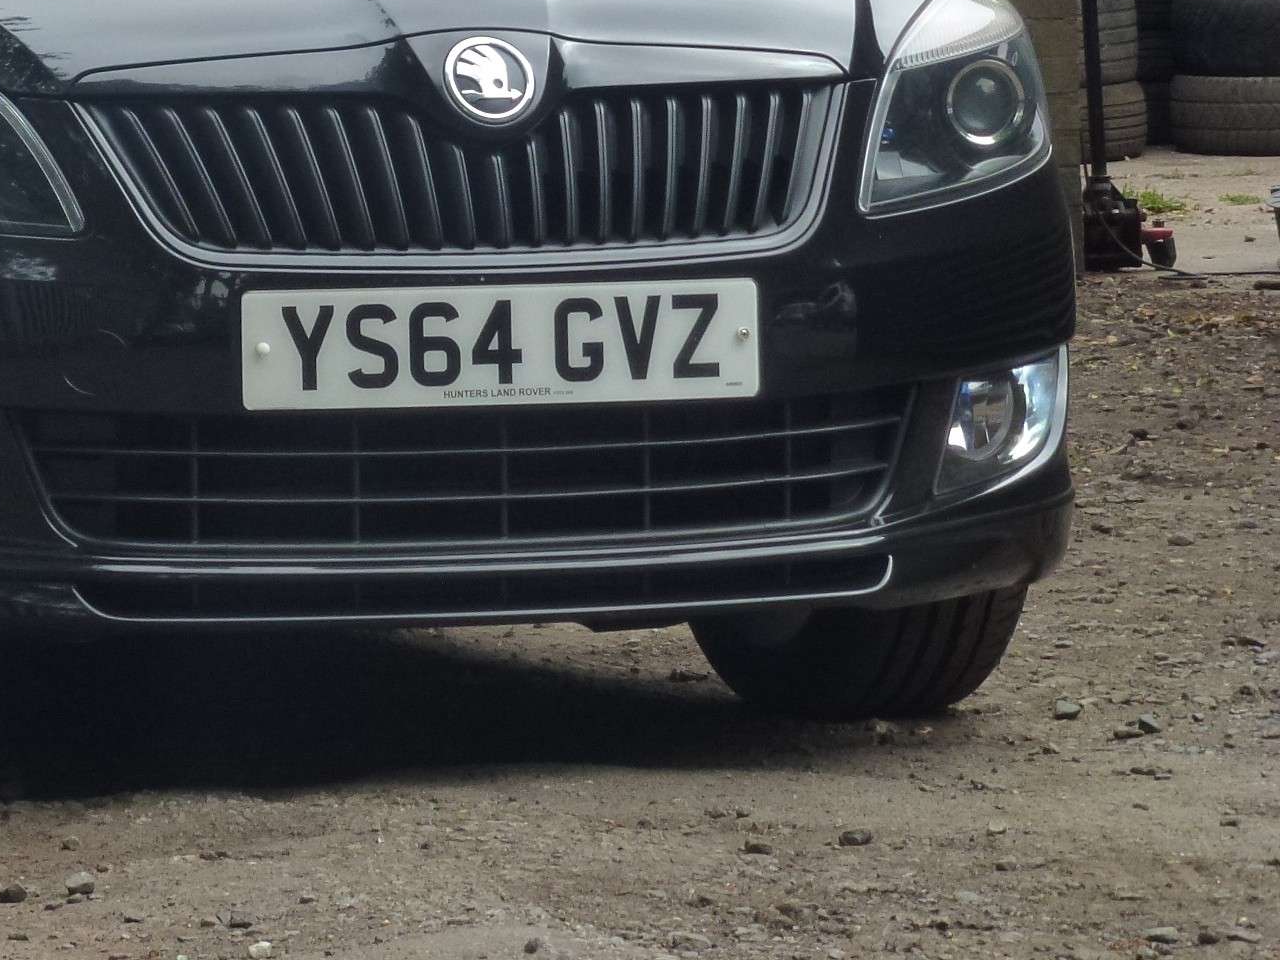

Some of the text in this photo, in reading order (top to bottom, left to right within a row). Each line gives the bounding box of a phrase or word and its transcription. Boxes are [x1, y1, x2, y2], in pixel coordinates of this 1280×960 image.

[281, 294, 720, 391] YS64 GVZ
[443, 390, 488, 399] HUNTERS
[491, 389, 516, 397] LAND
[519, 387, 551, 396] ROVER
